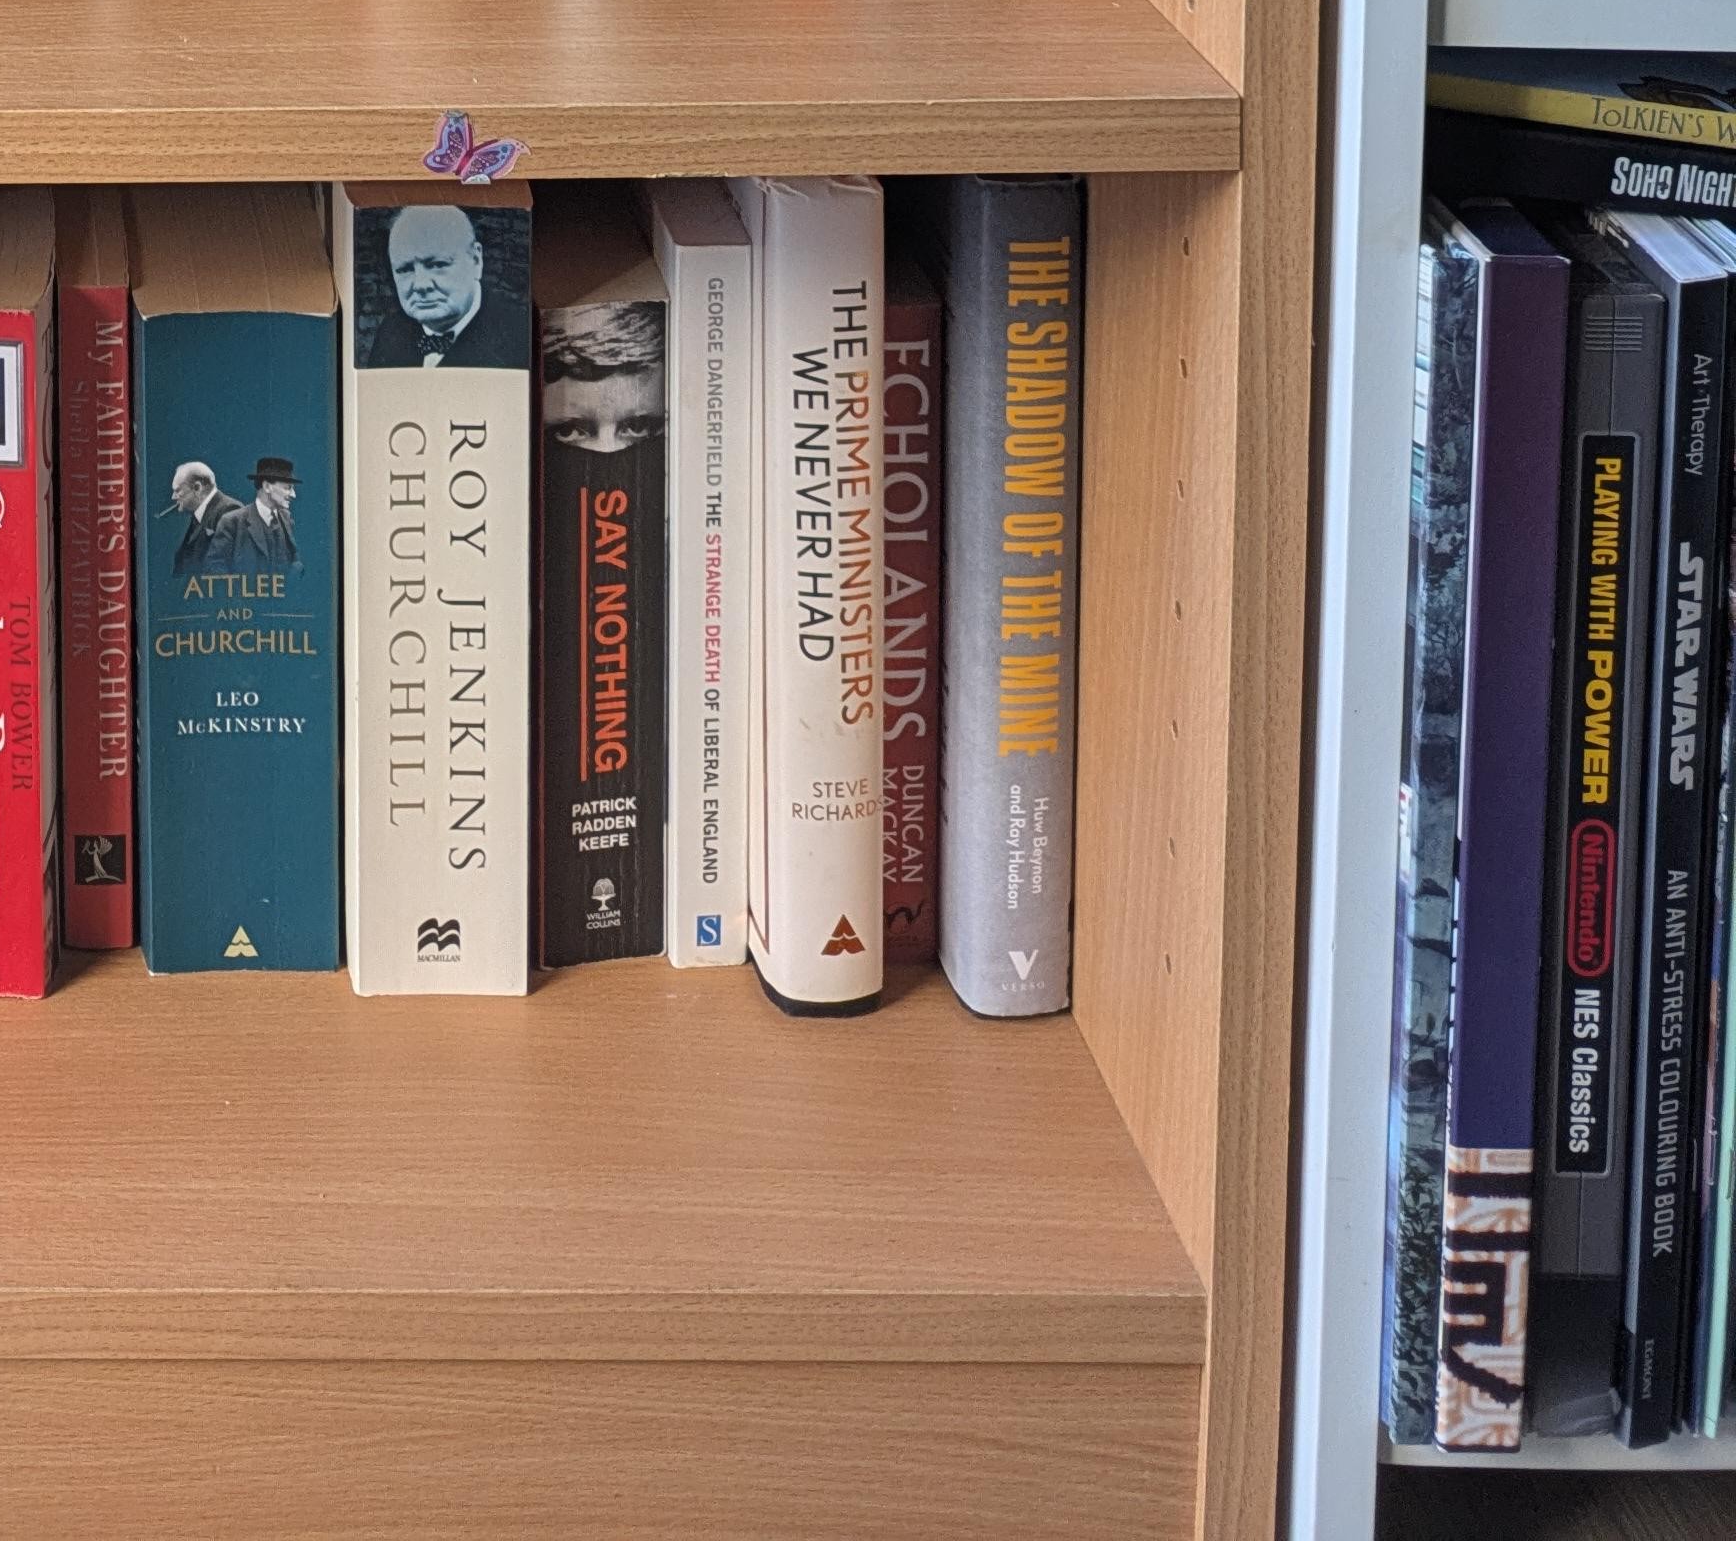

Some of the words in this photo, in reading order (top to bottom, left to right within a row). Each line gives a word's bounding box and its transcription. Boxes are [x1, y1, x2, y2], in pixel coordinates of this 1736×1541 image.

[593, 488, 630, 568] SAY
[1592, 456, 1622, 566] PLAYING
[183, 574, 286, 599] ATTLEE
[217, 607, 253, 621] AND
[1591, 574, 1617, 640] WITH
[1678, 542, 1704, 668] STAR
[155, 631, 317, 656] CHURCHILL
[216, 691, 260, 707] LEO
[594, 582, 630, 775] NOTHING
[1582, 648, 1615, 806] POWER
[1670, 671, 1702, 793] WARS
[571, 797, 636, 818] PATRICK
[573, 814, 636, 834] RADDEN
[578, 832, 630, 850] KEEFE
[1577, 832, 1606, 964] Nintendo
[1572, 988, 1601, 1038] NES
[1570, 1049, 1597, 1155] Classics
